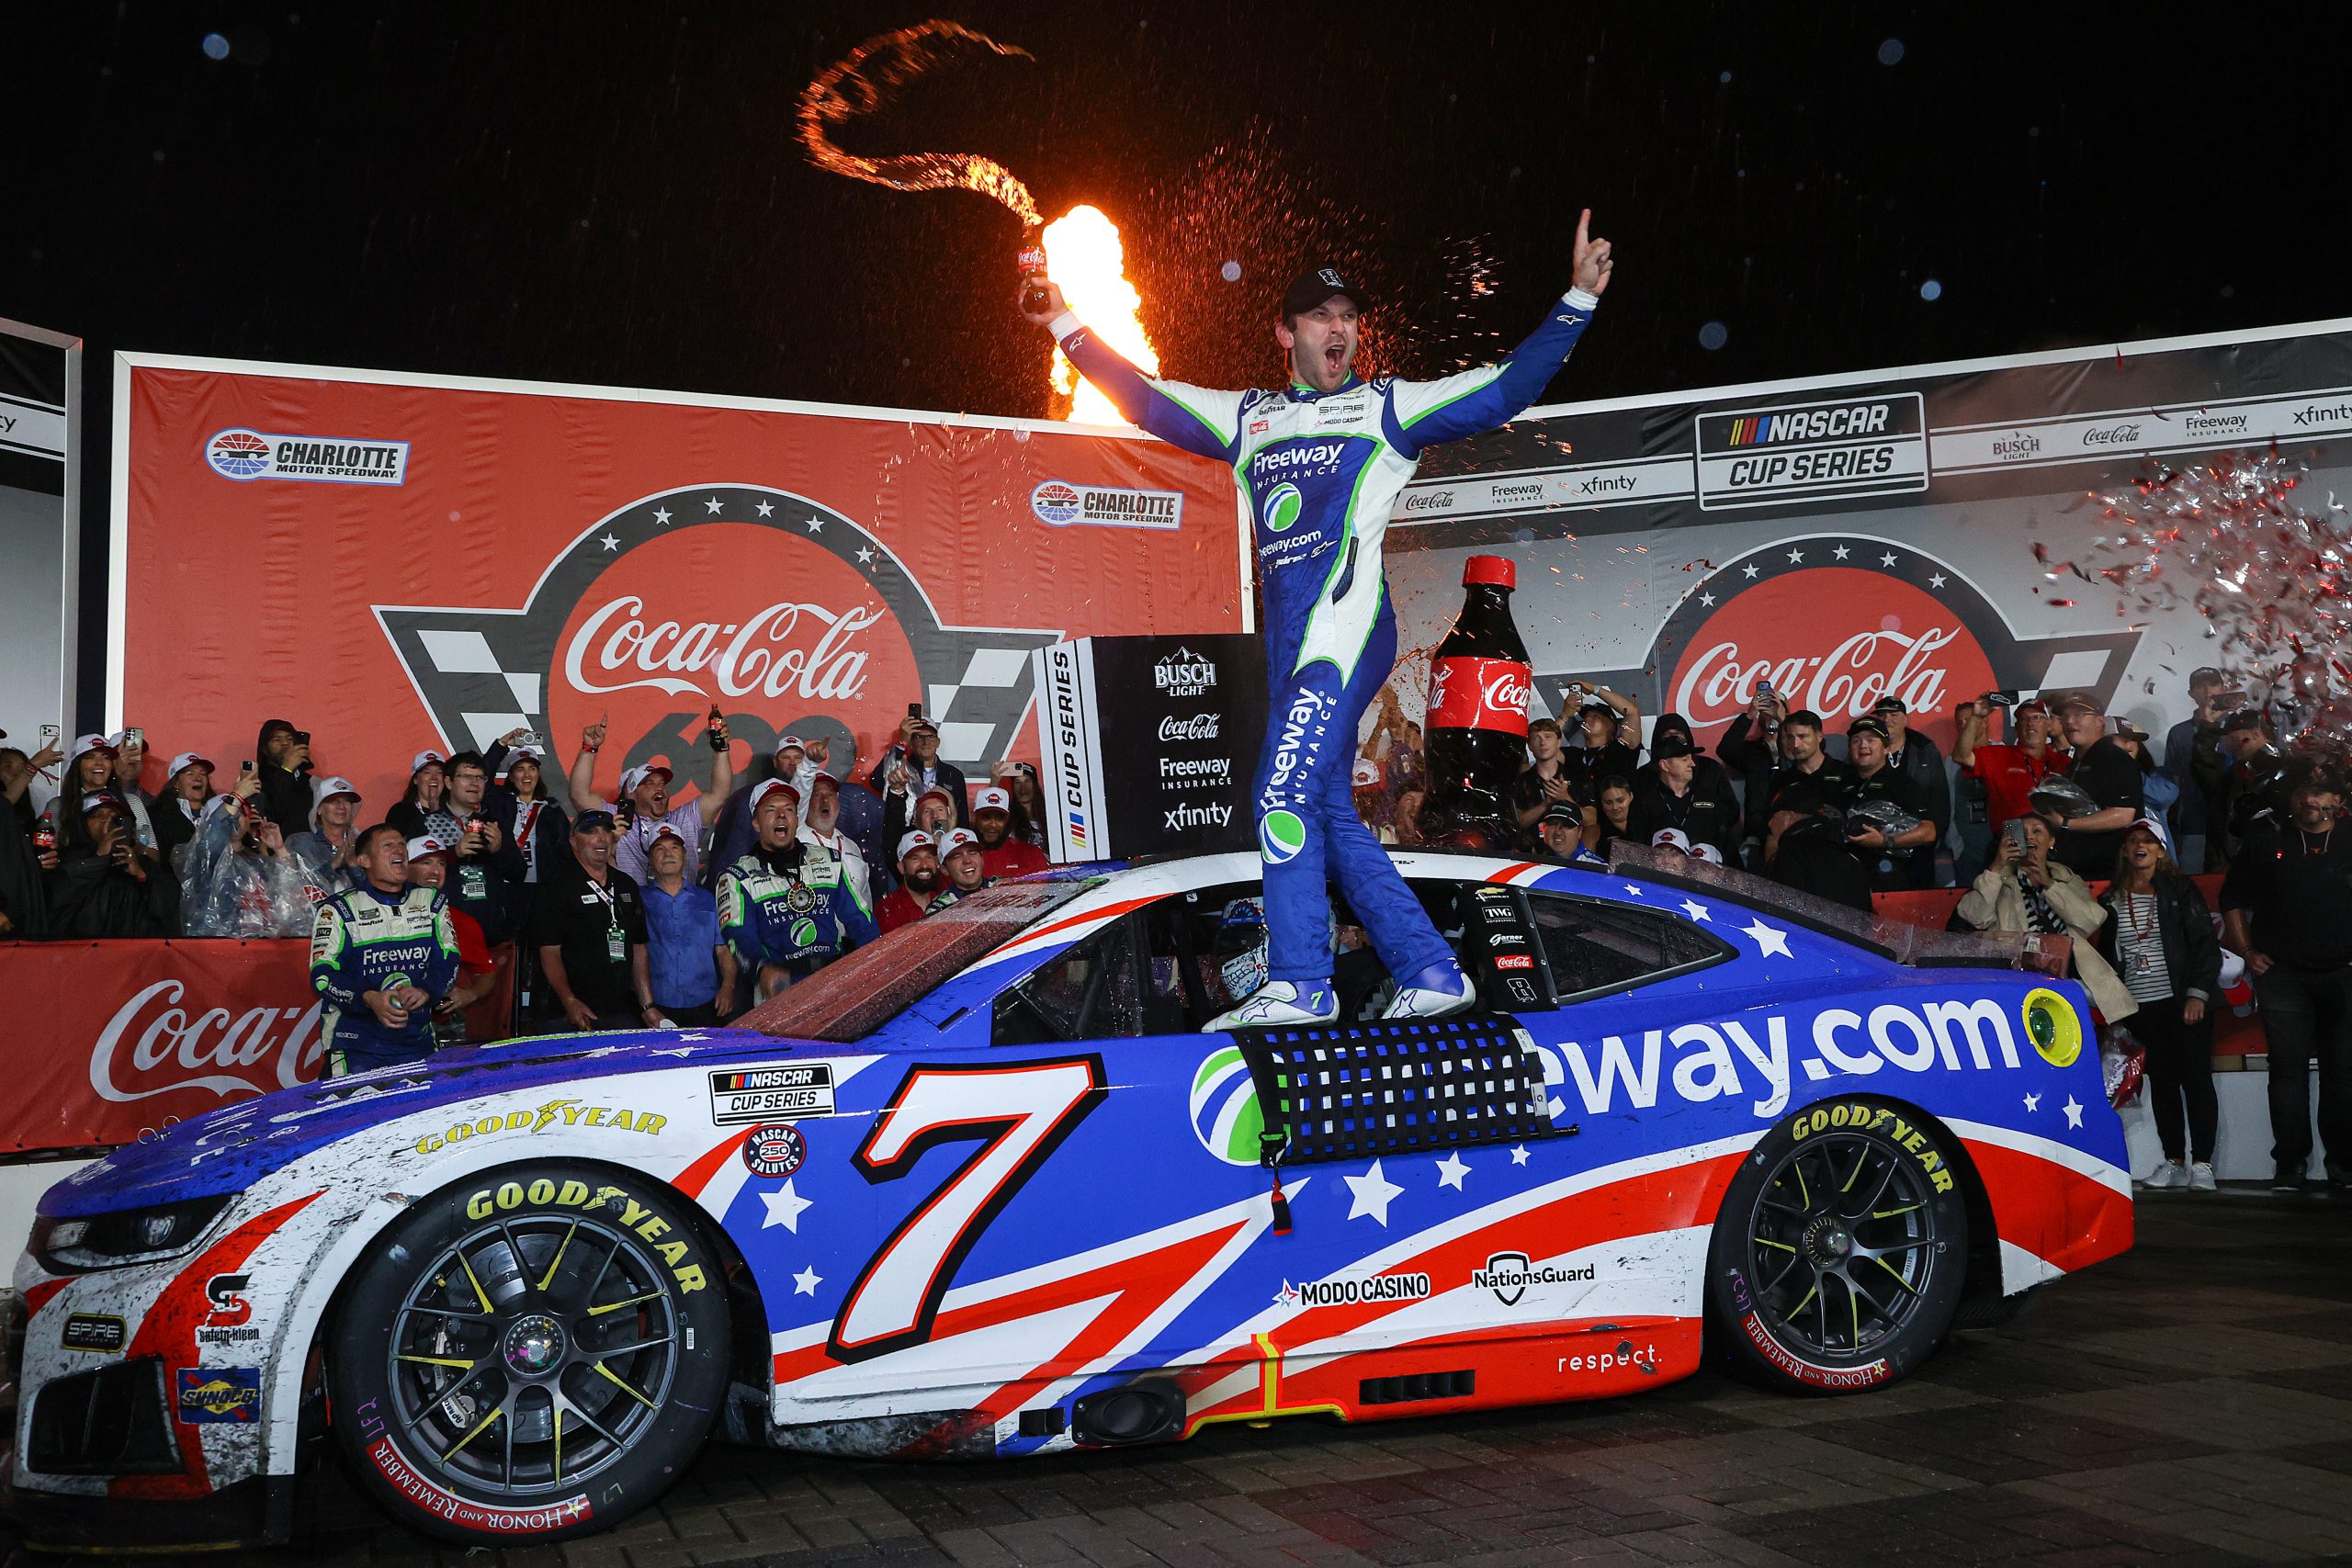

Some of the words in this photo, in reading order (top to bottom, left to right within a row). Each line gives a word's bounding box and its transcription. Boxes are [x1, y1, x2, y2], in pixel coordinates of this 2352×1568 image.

[1767, 404, 1890, 444] NASCAR
[2185, 413, 2247, 431] Freeway
[2186, 427, 2248, 437] INSURANCE
[2082, 424, 2142, 446] Coca-Cola
[276, 441, 399, 468] CHARLOTTE
[1992, 438, 2041, 456] BUSCH
[2003, 452, 2030, 461] LIGHT
[276, 464, 322, 475] MOTOR
[1253, 443, 1345, 477] Freeway
[1729, 454, 1787, 487] CUP
[1791, 446, 1894, 481] SERIES
[1491, 484, 1544, 497] Freeway
[1580, 475, 1637, 495] xfinity
[1083, 491, 1176, 515] CHARLOTTE
[1406, 491, 1455, 511] Coca-Cola
[1492, 495, 1544, 504] INSURANCE
[1084, 512, 1120, 521] MOTOR
[564, 595, 887, 700] Coca-Cola
[1153, 663, 1217, 688] BUSCH
[1674, 626, 1962, 728] Coca-Cola
[1054, 650, 1077, 749] SERIES
[1169, 685, 1204, 697] LIGHT
[1158, 713, 1221, 742] Coca-Cola
[1260, 686, 1323, 812] Freeway
[1294, 695, 1338, 813] NSURANCE
[1159, 757, 1231, 777] Freeway
[1064, 751, 1082, 808] CUP
[1161, 777, 1232, 791] INSURANCE
[1164, 801, 1233, 831] xfinity
[763, 892, 831, 917] Freay
[1485, 908, 1512, 918] TWG
[1488, 933, 1524, 947] Garner
[363, 946, 432, 965] Freeway
[1497, 956, 1531, 969] Coca-Cola
[363, 963, 429, 976] INSURANC
[1310, 990, 1324, 1010] 7
[89, 979, 323, 1102] Coca-C
[751, 1069, 813, 1088] NASCAR
[730, 1094, 762, 1111] CUP
[763, 1091, 817, 1109] SERIES
[415, 1100, 668, 1156] GOODYEAR
[752, 1128, 797, 1145] NASCAR
[761, 1146, 789, 1156] 250
[1792, 1105, 1954, 1194] GOODYEAR
[751, 1155, 799, 1174] SALUTES
[825, 1052, 1109, 1366] 7
[466, 1179, 707, 1295] GOODYEAR
[1474, 1263, 1595, 1289] NationsGuard
[1300, 1281, 1358, 1305] MODO
[1359, 1273, 1429, 1301] CASINO
[68, 1322, 120, 1338] SPIRE
[1746, 1316, 1805, 1378] REMEMBER
[1557, 1343, 1662, 1373] respect.
[1804, 1371, 1822, 1380] AND
[1822, 1369, 1874, 1386] HONOR
[184, 1388, 256, 1405] SUNOCO
[375, 1442, 459, 1520] REMEMBER
[459, 1509, 484, 1522] AND
[488, 1507, 563, 1529] HONOR
